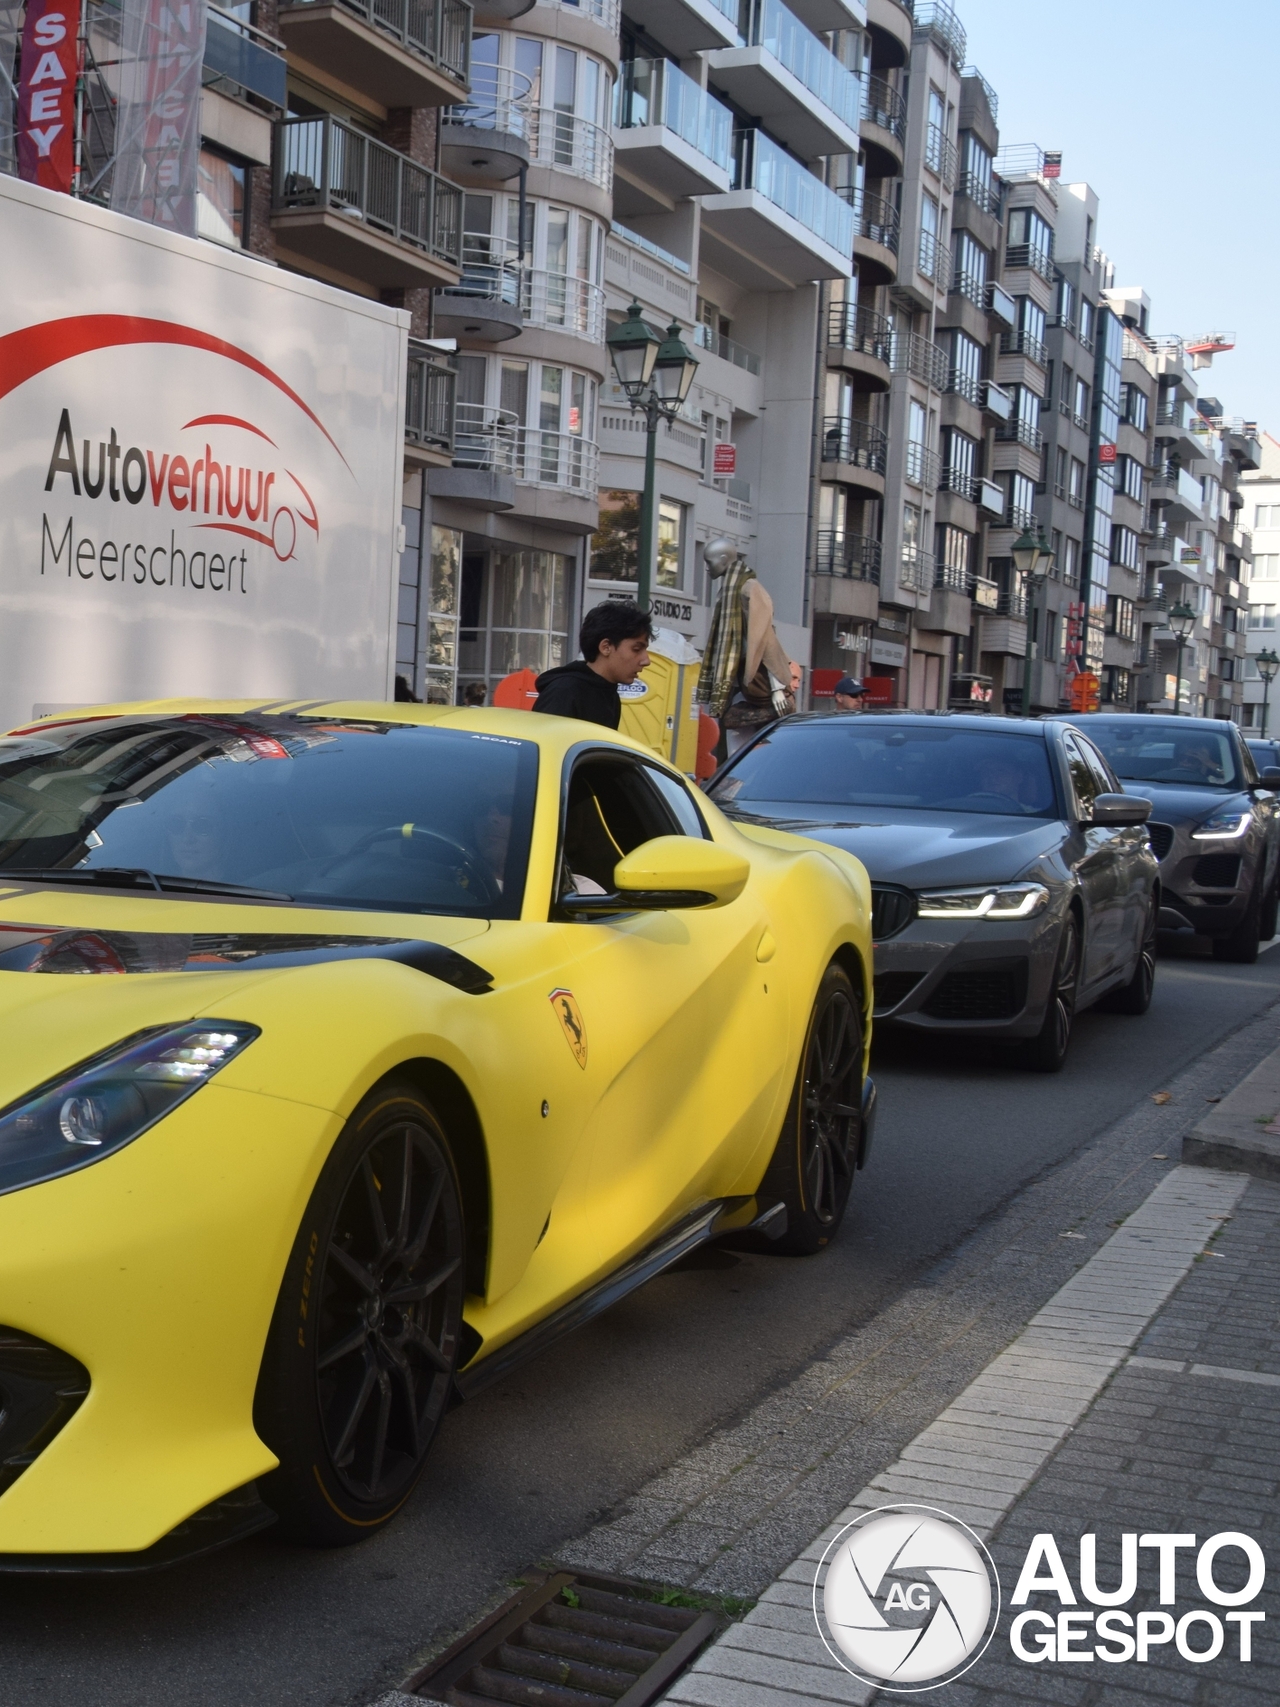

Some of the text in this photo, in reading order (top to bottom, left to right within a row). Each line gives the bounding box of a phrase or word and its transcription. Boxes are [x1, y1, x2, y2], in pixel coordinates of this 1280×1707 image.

[27, 13, 67, 157] SAEY
[44, 408, 276, 523] Autoverhuur
[41, 513, 248, 594] Meerschaert
[654, 600, 680, 620] STUDIO
[1066, 602, 1085, 675] HEMA
[470, 735, 522, 746] ASCARI
[301, 1231, 318, 1319] ZERO
